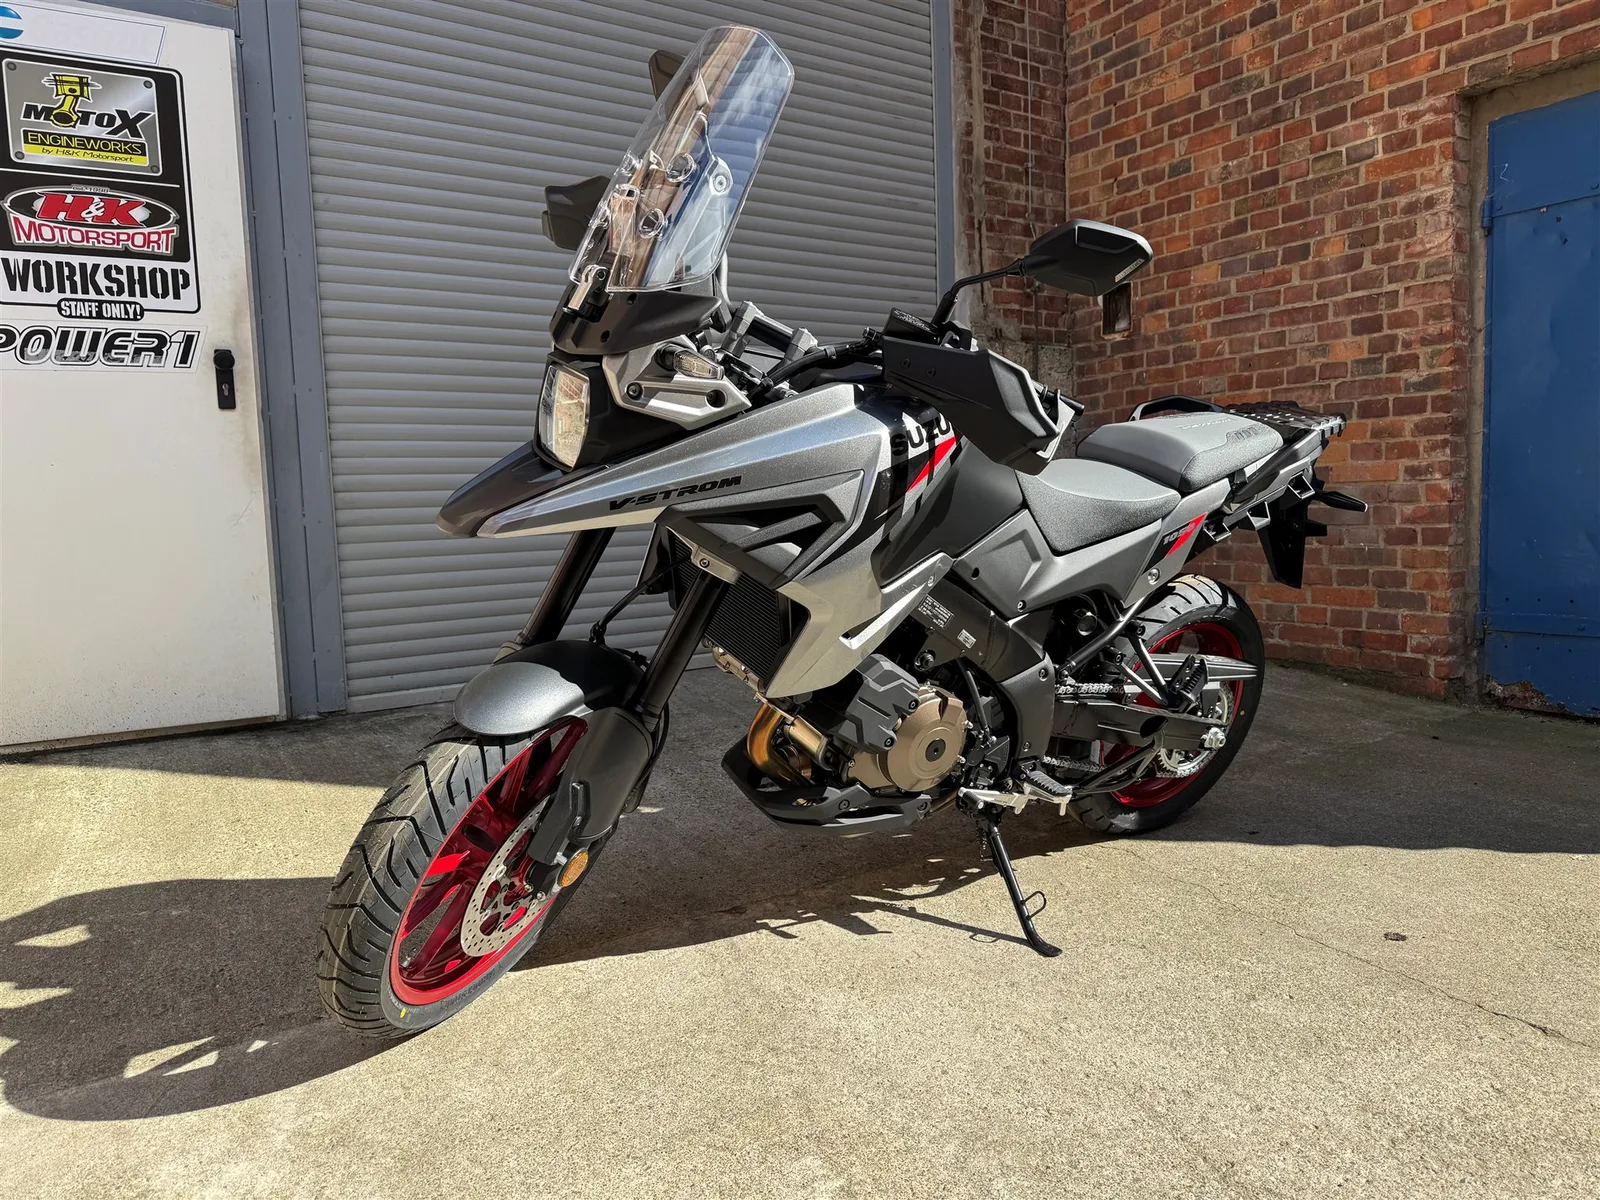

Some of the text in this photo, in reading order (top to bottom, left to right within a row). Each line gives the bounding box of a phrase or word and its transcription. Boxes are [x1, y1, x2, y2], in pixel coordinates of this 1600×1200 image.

[28, 132, 142, 154] ENGINEWORKS
[41, 147, 134, 163] by H&K Motorsport
[36, 191, 147, 228] H&K
[13, 217, 177, 253] MOTORSPORT
[1, 257, 191, 300] WORKSHOP
[60, 301, 142, 320] STAFF ONLY!
[609, 475, 742, 511] V-STROM
